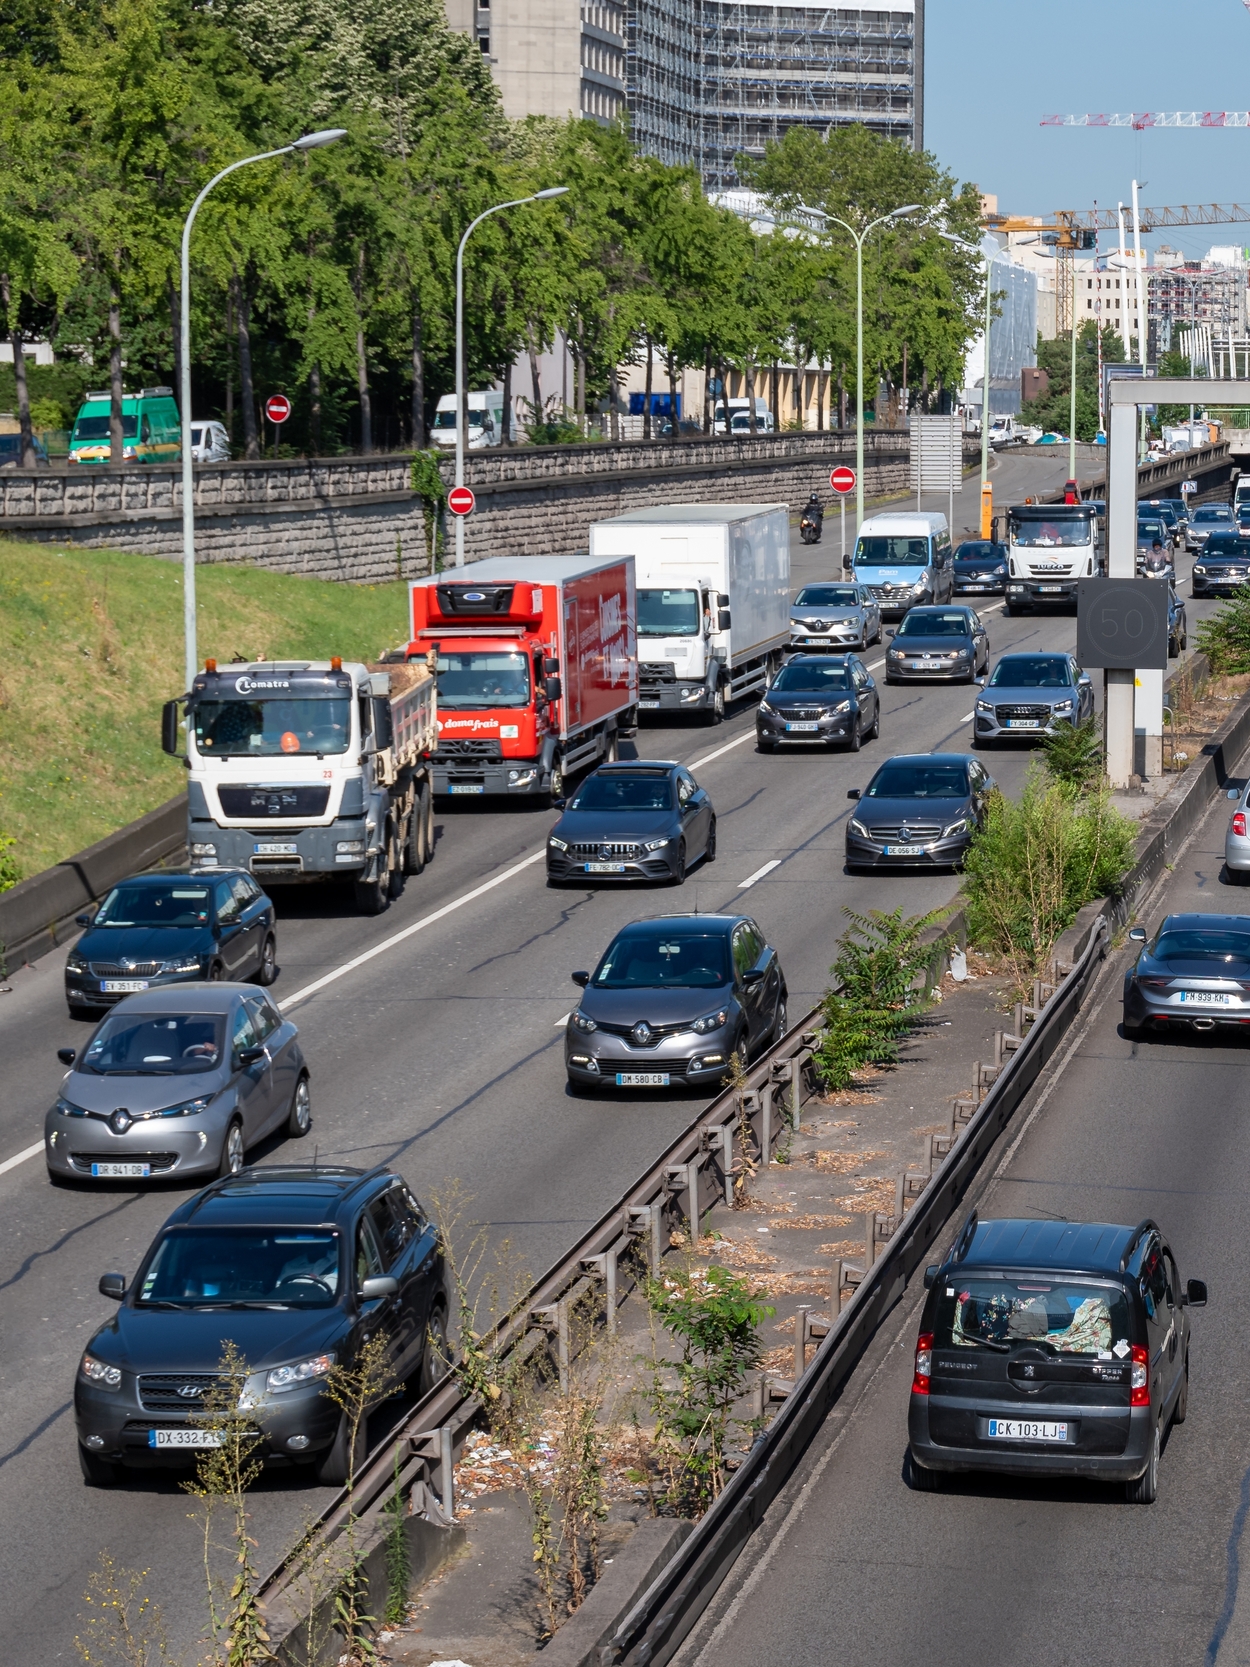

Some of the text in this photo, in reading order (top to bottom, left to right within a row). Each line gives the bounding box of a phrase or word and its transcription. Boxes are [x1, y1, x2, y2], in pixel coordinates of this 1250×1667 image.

[1102, 608, 1144, 638] 50
[244, 680, 290, 689] Lomatra
[444, 718, 499, 732] domafrais
[322, 770, 333, 778] 23
[251, 795, 298, 805] MAN
[938, 1361, 978, 1370] PEUGEOT
